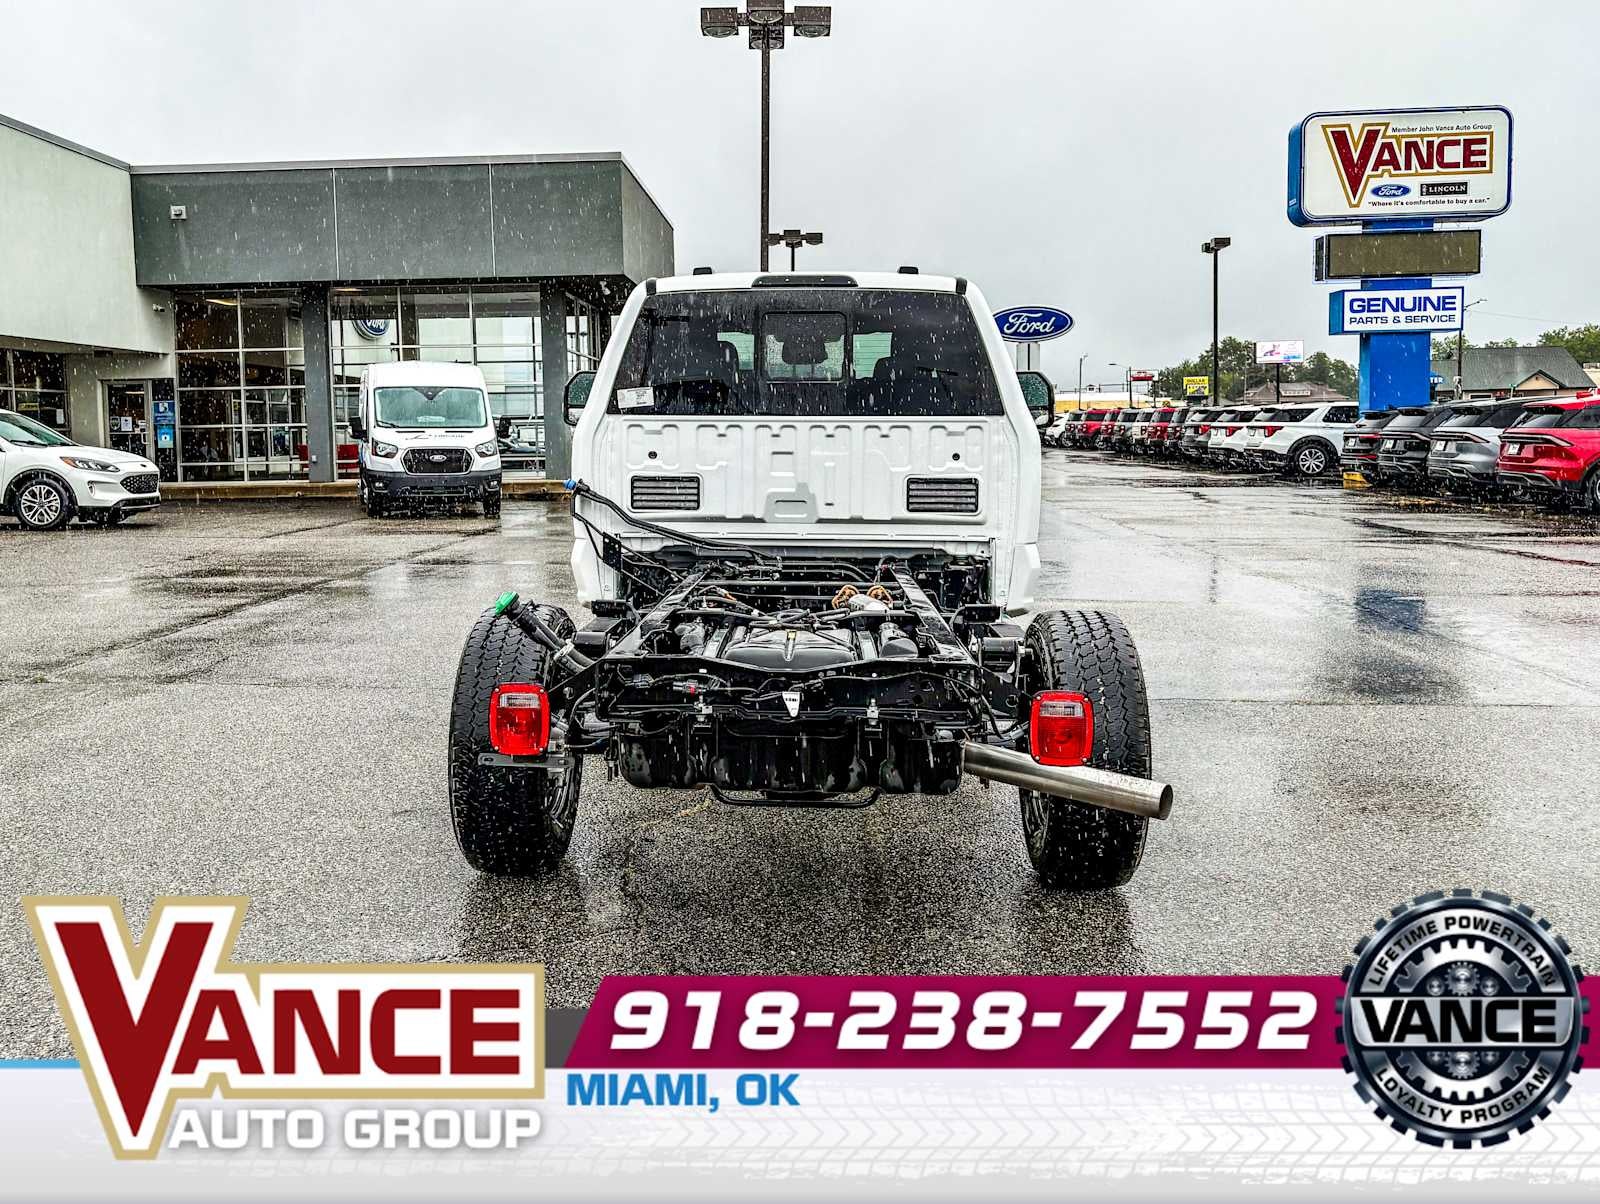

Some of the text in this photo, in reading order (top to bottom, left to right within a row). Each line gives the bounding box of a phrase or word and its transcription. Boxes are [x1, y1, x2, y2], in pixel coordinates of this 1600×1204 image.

[1330, 128, 1487, 201] VANCE
[1378, 185, 1403, 196] Ford
[1429, 185, 1466, 193] LINCOLN
[1349, 296, 1457, 313] GENUINE
[1004, 312, 1056, 334] Ford
[1349, 314, 1456, 325] PARTS & SERVICE
